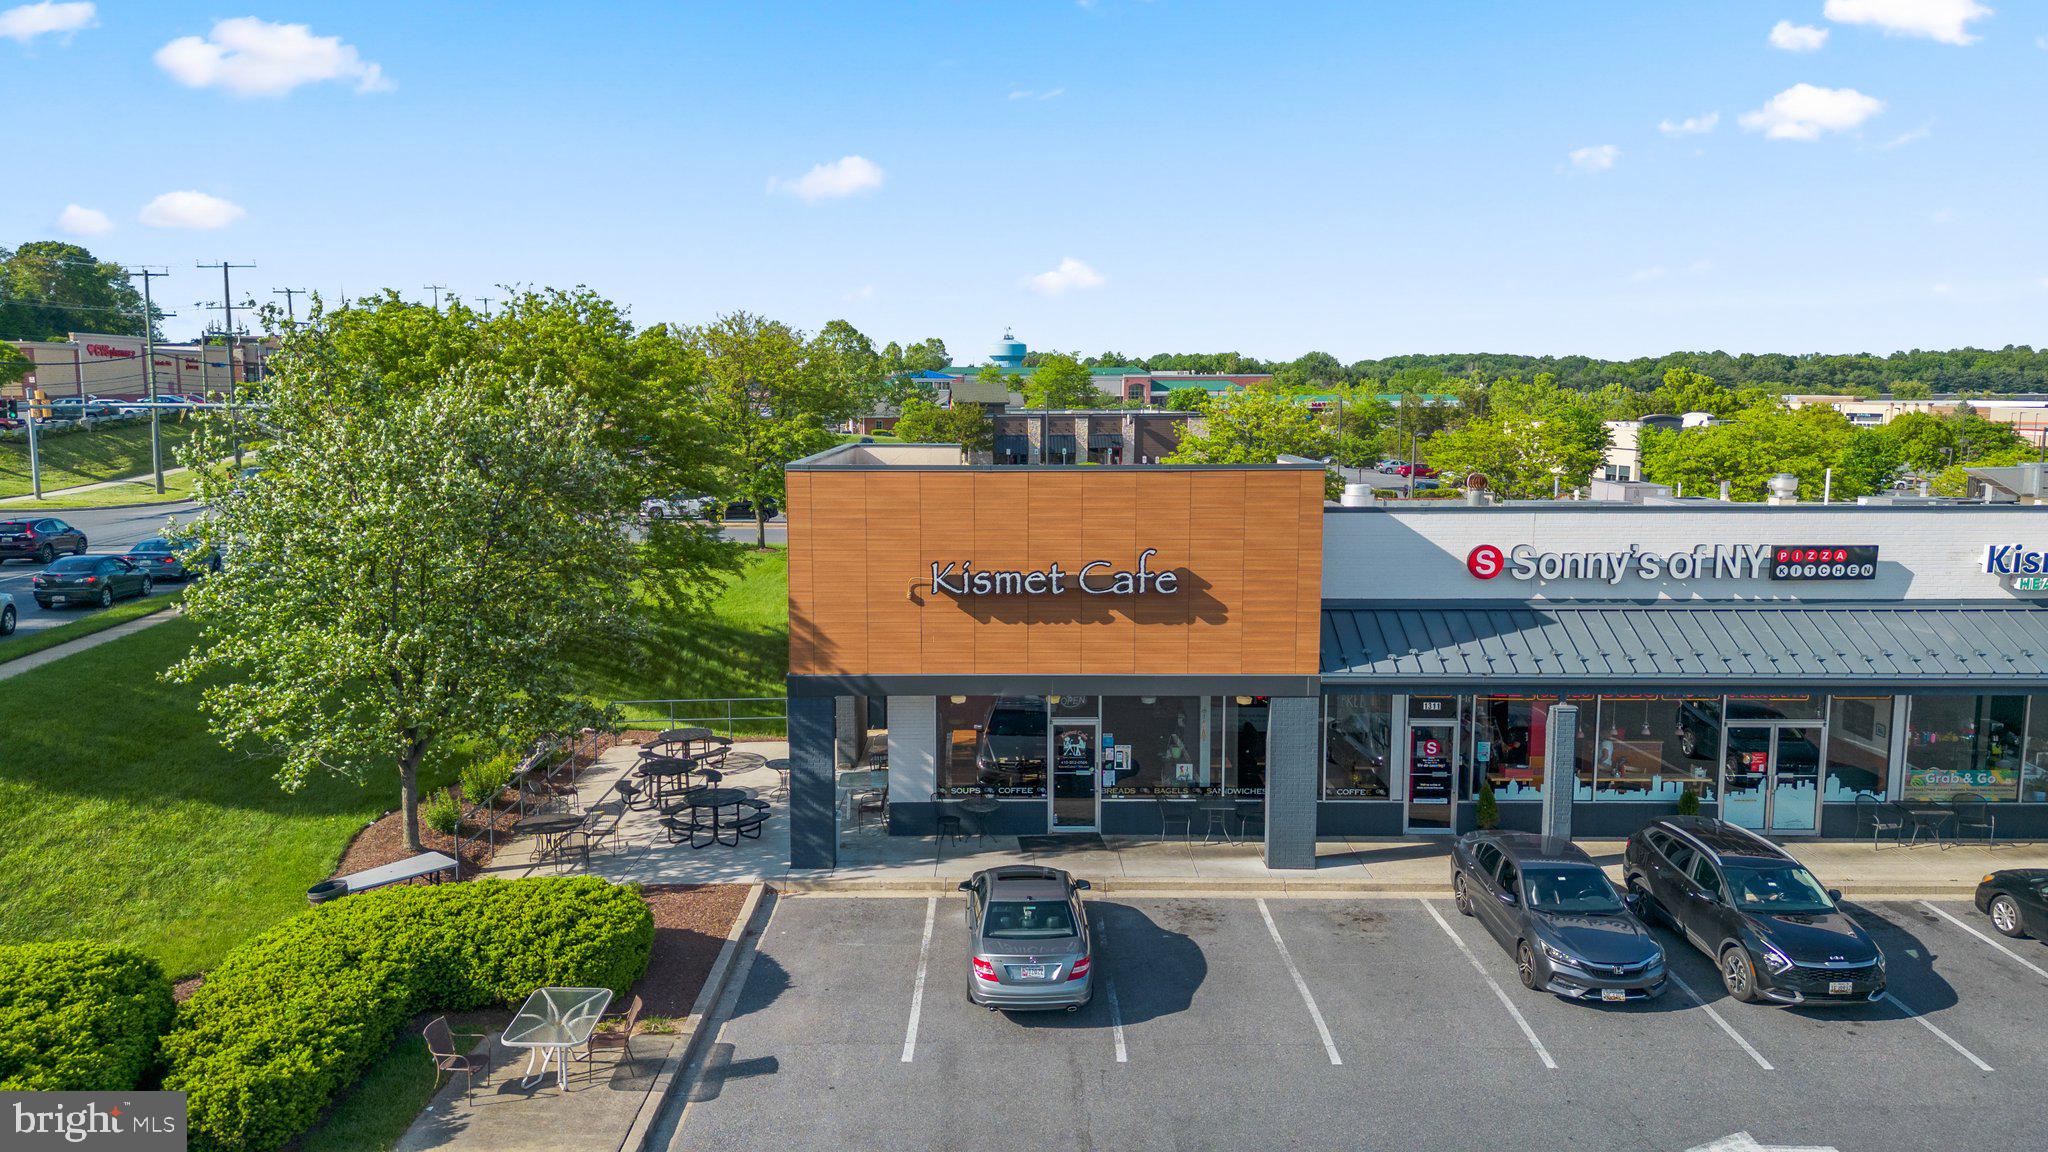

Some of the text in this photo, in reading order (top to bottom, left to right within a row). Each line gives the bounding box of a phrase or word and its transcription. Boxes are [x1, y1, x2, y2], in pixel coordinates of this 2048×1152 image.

[1777, 549, 1848, 563] PIZZA
[1510, 543, 1772, 585] Sonny's of NY
[931, 548, 1178, 595] Kismet Cafe
[1776, 564, 1873, 578] KITCHEN
[1423, 702, 1441, 710] 1311
[1925, 773, 1997, 784] Grab & Go
[1101, 787, 1136, 795] BREADS
[1154, 787, 1189, 795] BAGELS
[1336, 788, 1372, 796] COFFEE
